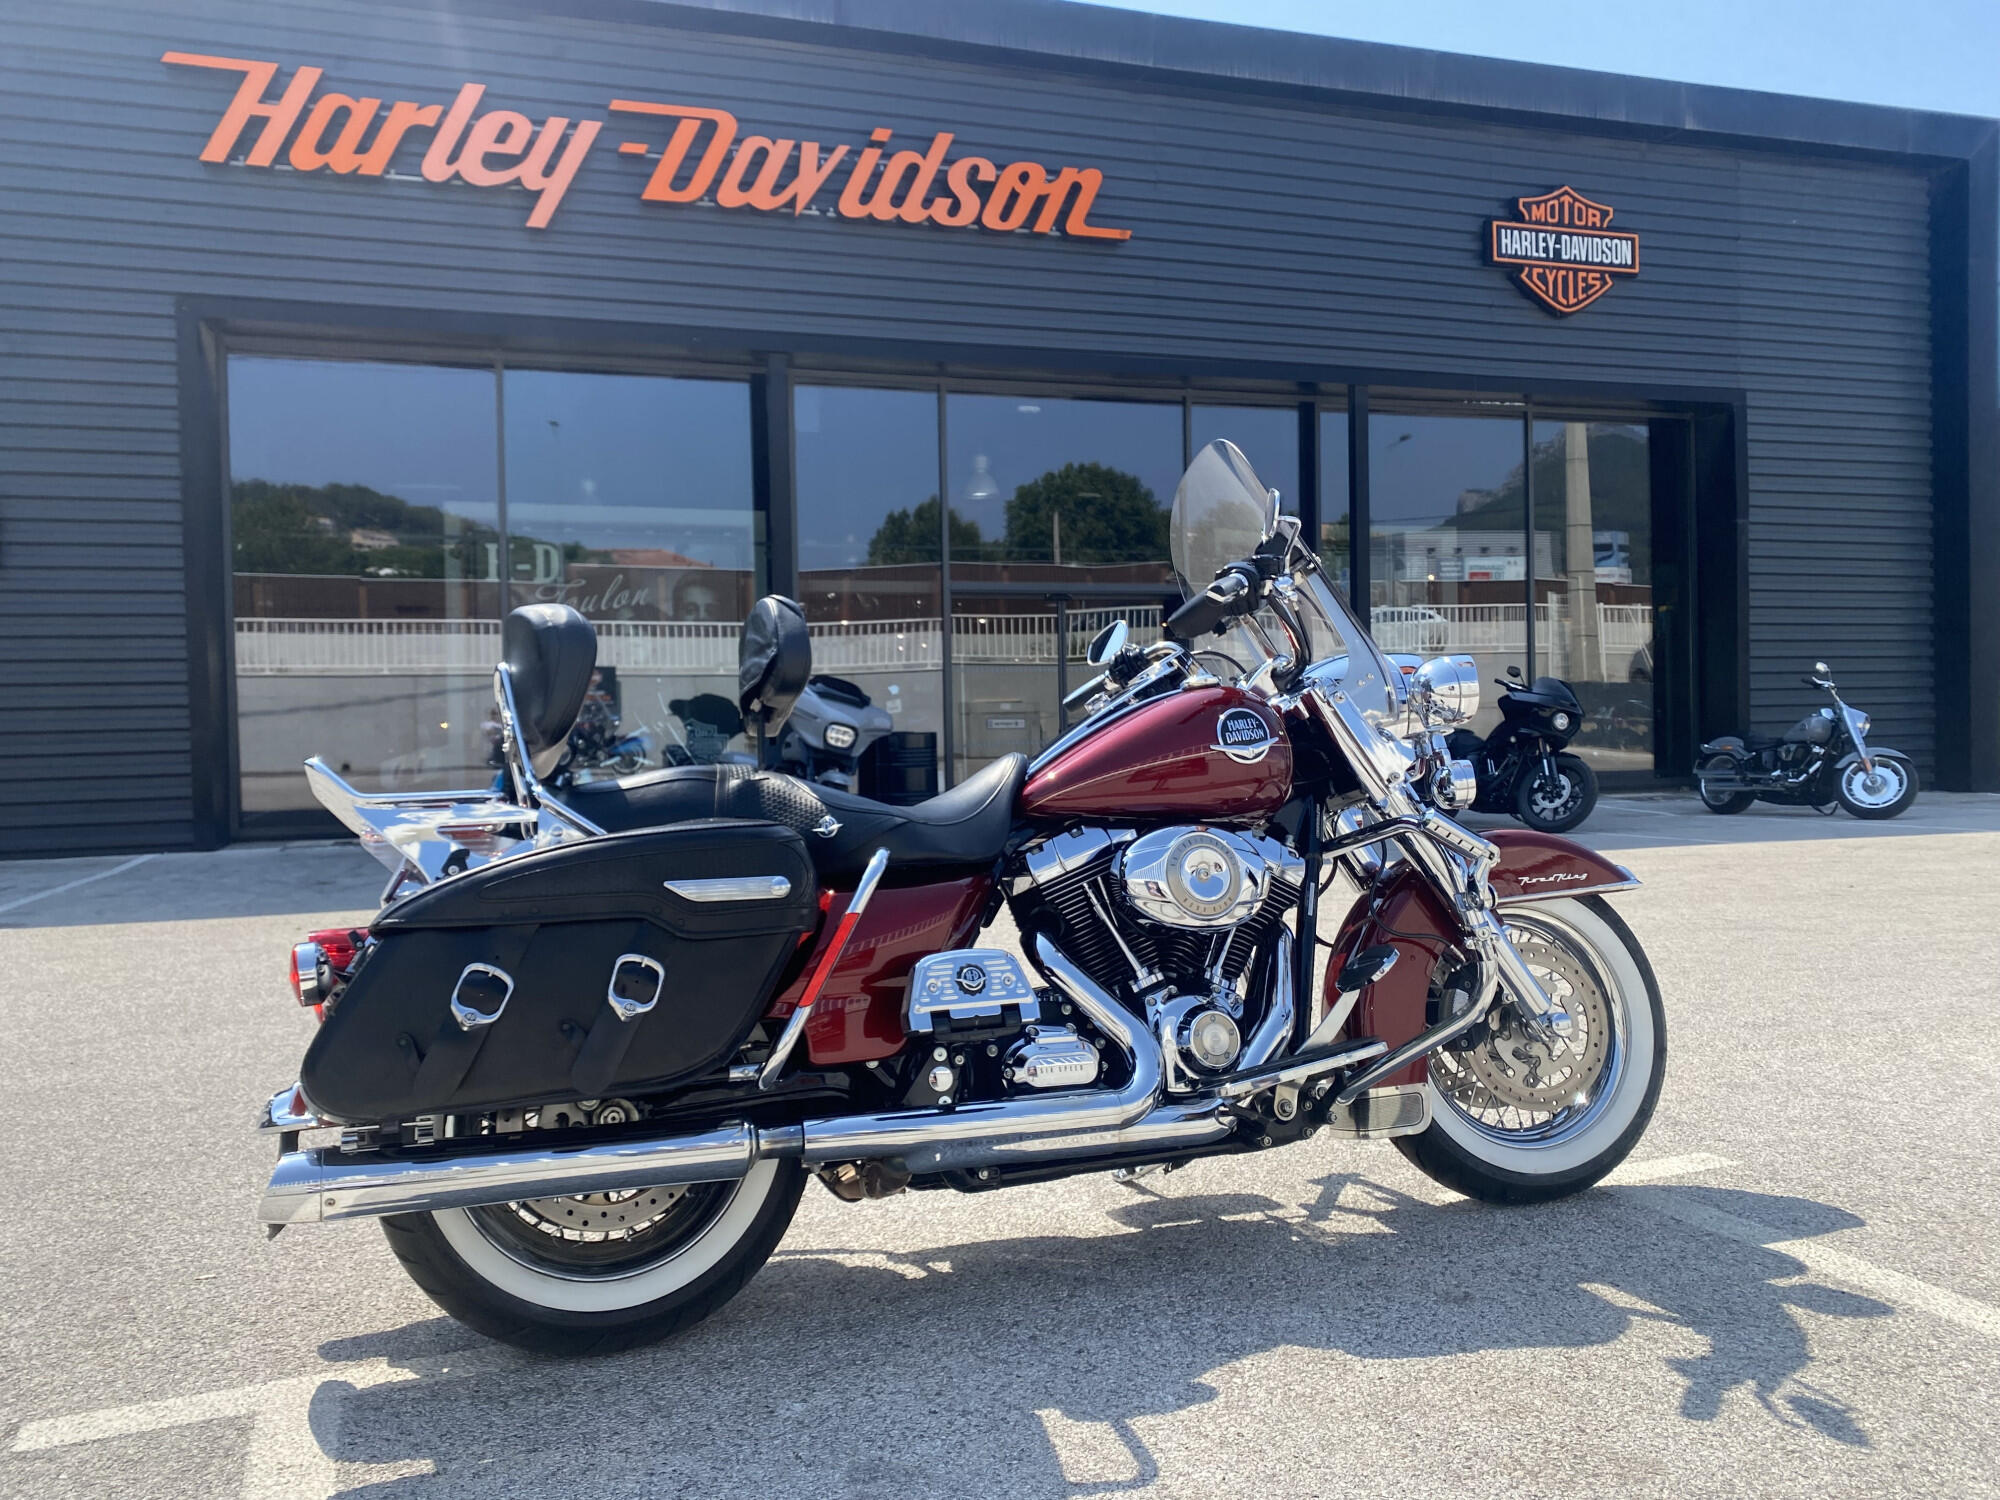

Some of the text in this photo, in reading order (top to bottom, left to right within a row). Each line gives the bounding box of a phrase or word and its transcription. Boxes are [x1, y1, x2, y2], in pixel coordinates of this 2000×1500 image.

[1531, 194, 1601, 228] MOTOR
[1501, 228, 1632, 265] HARLEY-DAVIDSON
[1532, 267, 1601, 305] CYCLES
[1225, 728, 1265, 744] DAVIDSON
